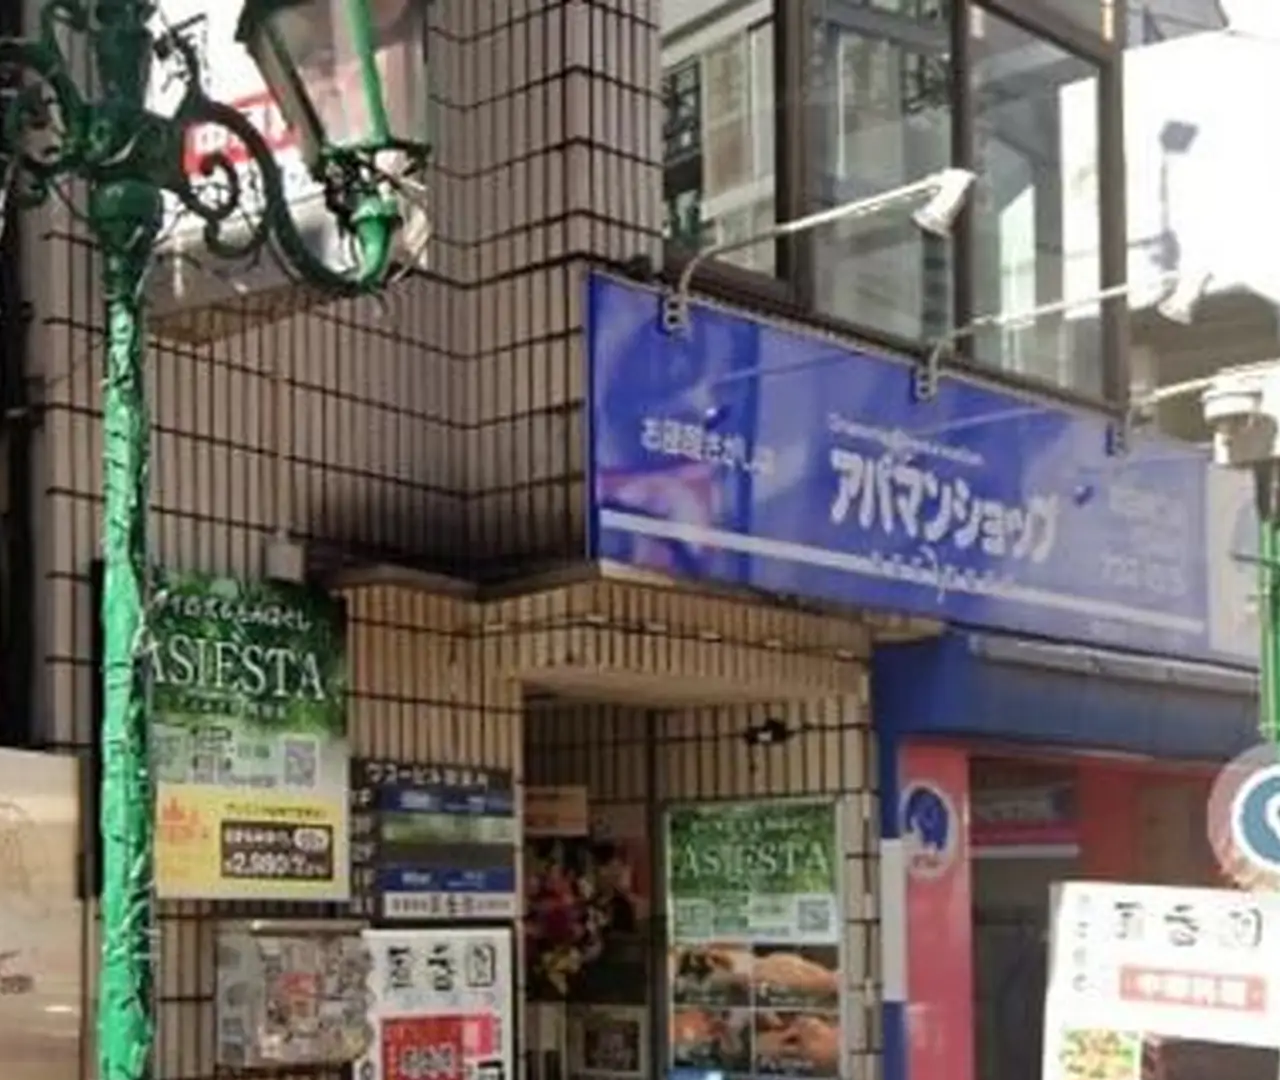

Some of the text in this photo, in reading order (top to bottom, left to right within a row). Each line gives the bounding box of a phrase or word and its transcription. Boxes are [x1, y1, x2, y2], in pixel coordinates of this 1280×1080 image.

[830, 446, 1061, 565] アパマンショップ
[678, 839, 830, 880] ASIESTA
